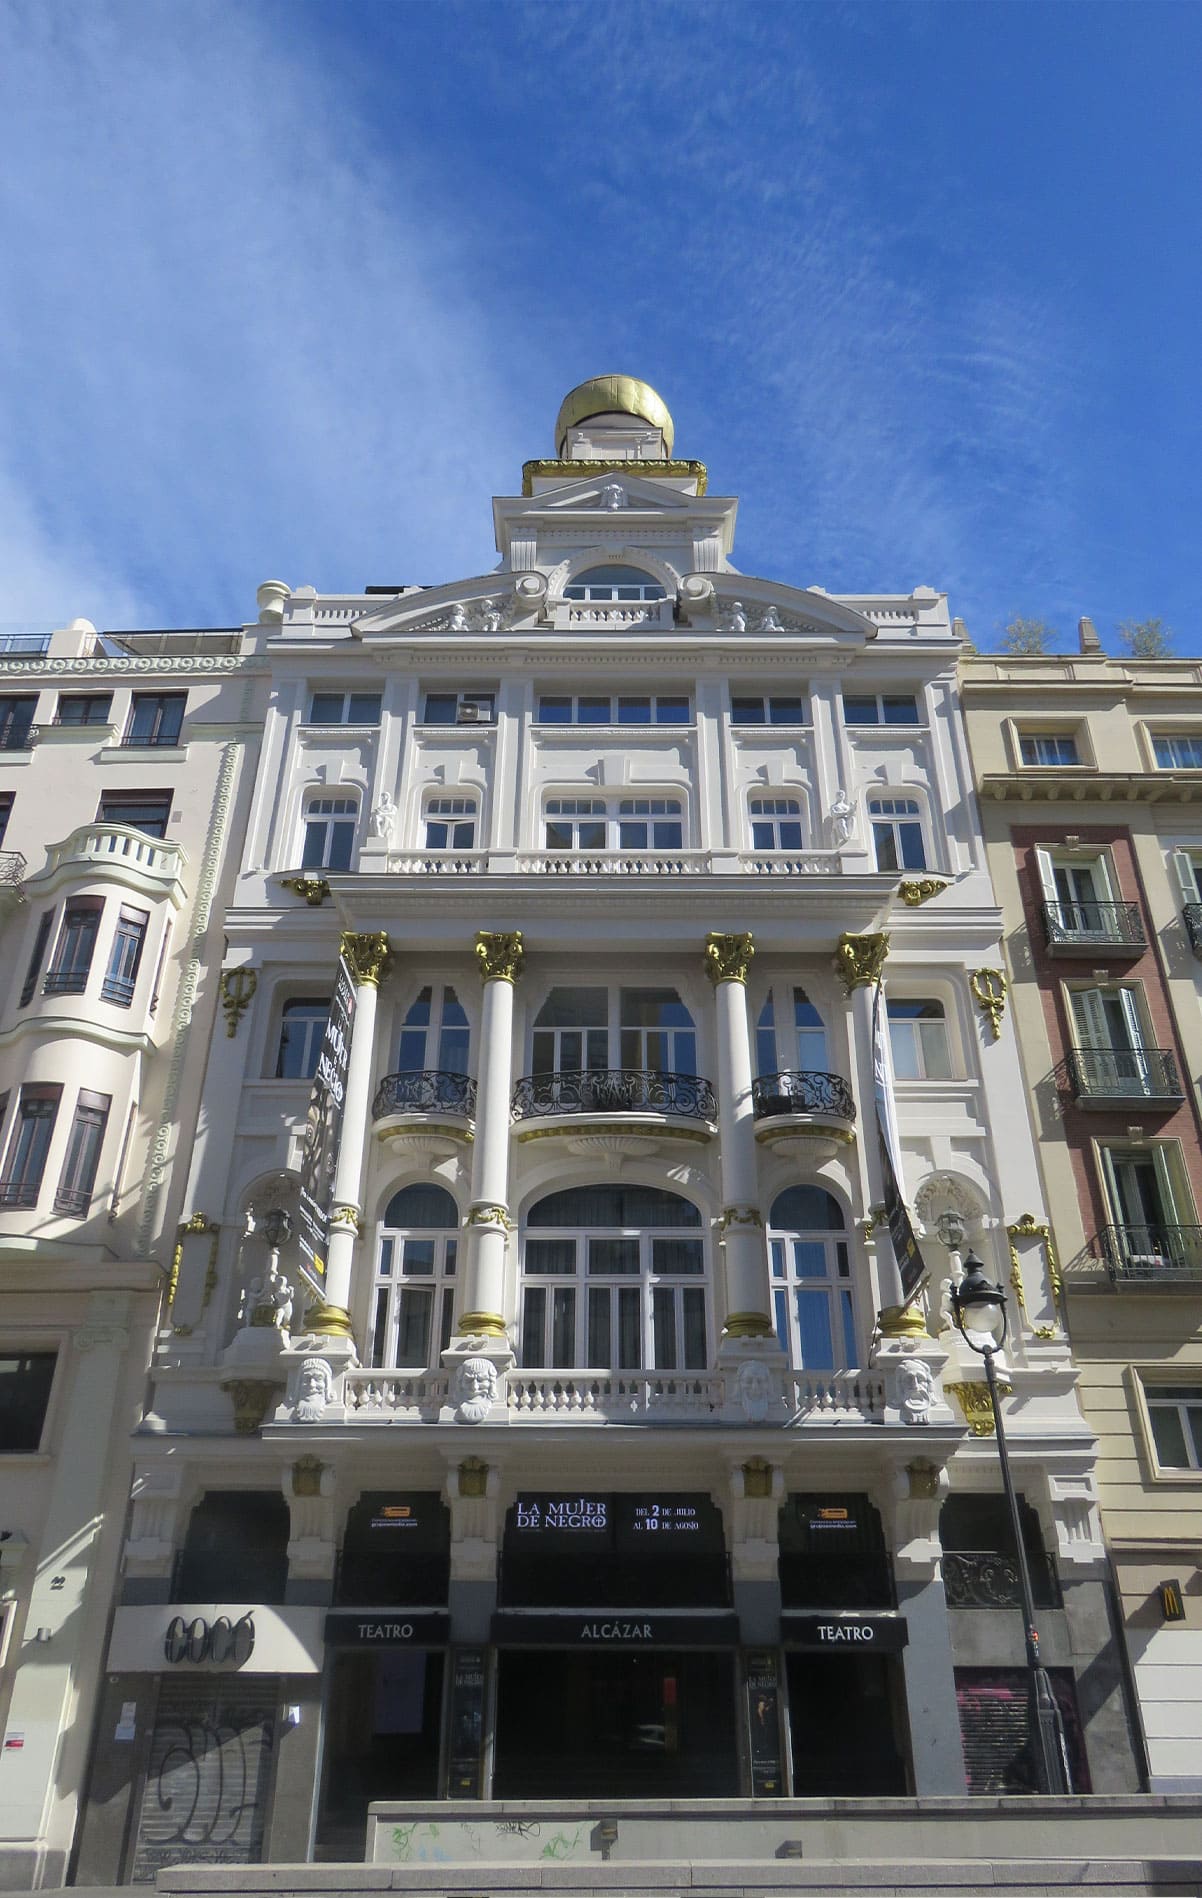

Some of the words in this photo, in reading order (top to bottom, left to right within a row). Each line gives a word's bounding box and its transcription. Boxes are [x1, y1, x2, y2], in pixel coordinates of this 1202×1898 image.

[517, 1503, 540, 1514] LA
[549, 1499, 606, 1514] MUJER
[636, 1508, 649, 1516] DEL
[652, 1505, 660, 1516] 2
[662, 1508, 672, 1516] DE
[674, 1508, 696, 1516] JULIO
[517, 1515, 540, 1527] DE
[545, 1515, 607, 1528] NEGRO
[633, 1522, 643, 1530] AL
[645, 1518, 658, 1530] 10
[662, 1522, 671, 1530] DE
[358, 1624, 413, 1639] TEATRO
[581, 1621, 653, 1639] ALCÁZAR
[817, 1626, 874, 1640] TEATRO
